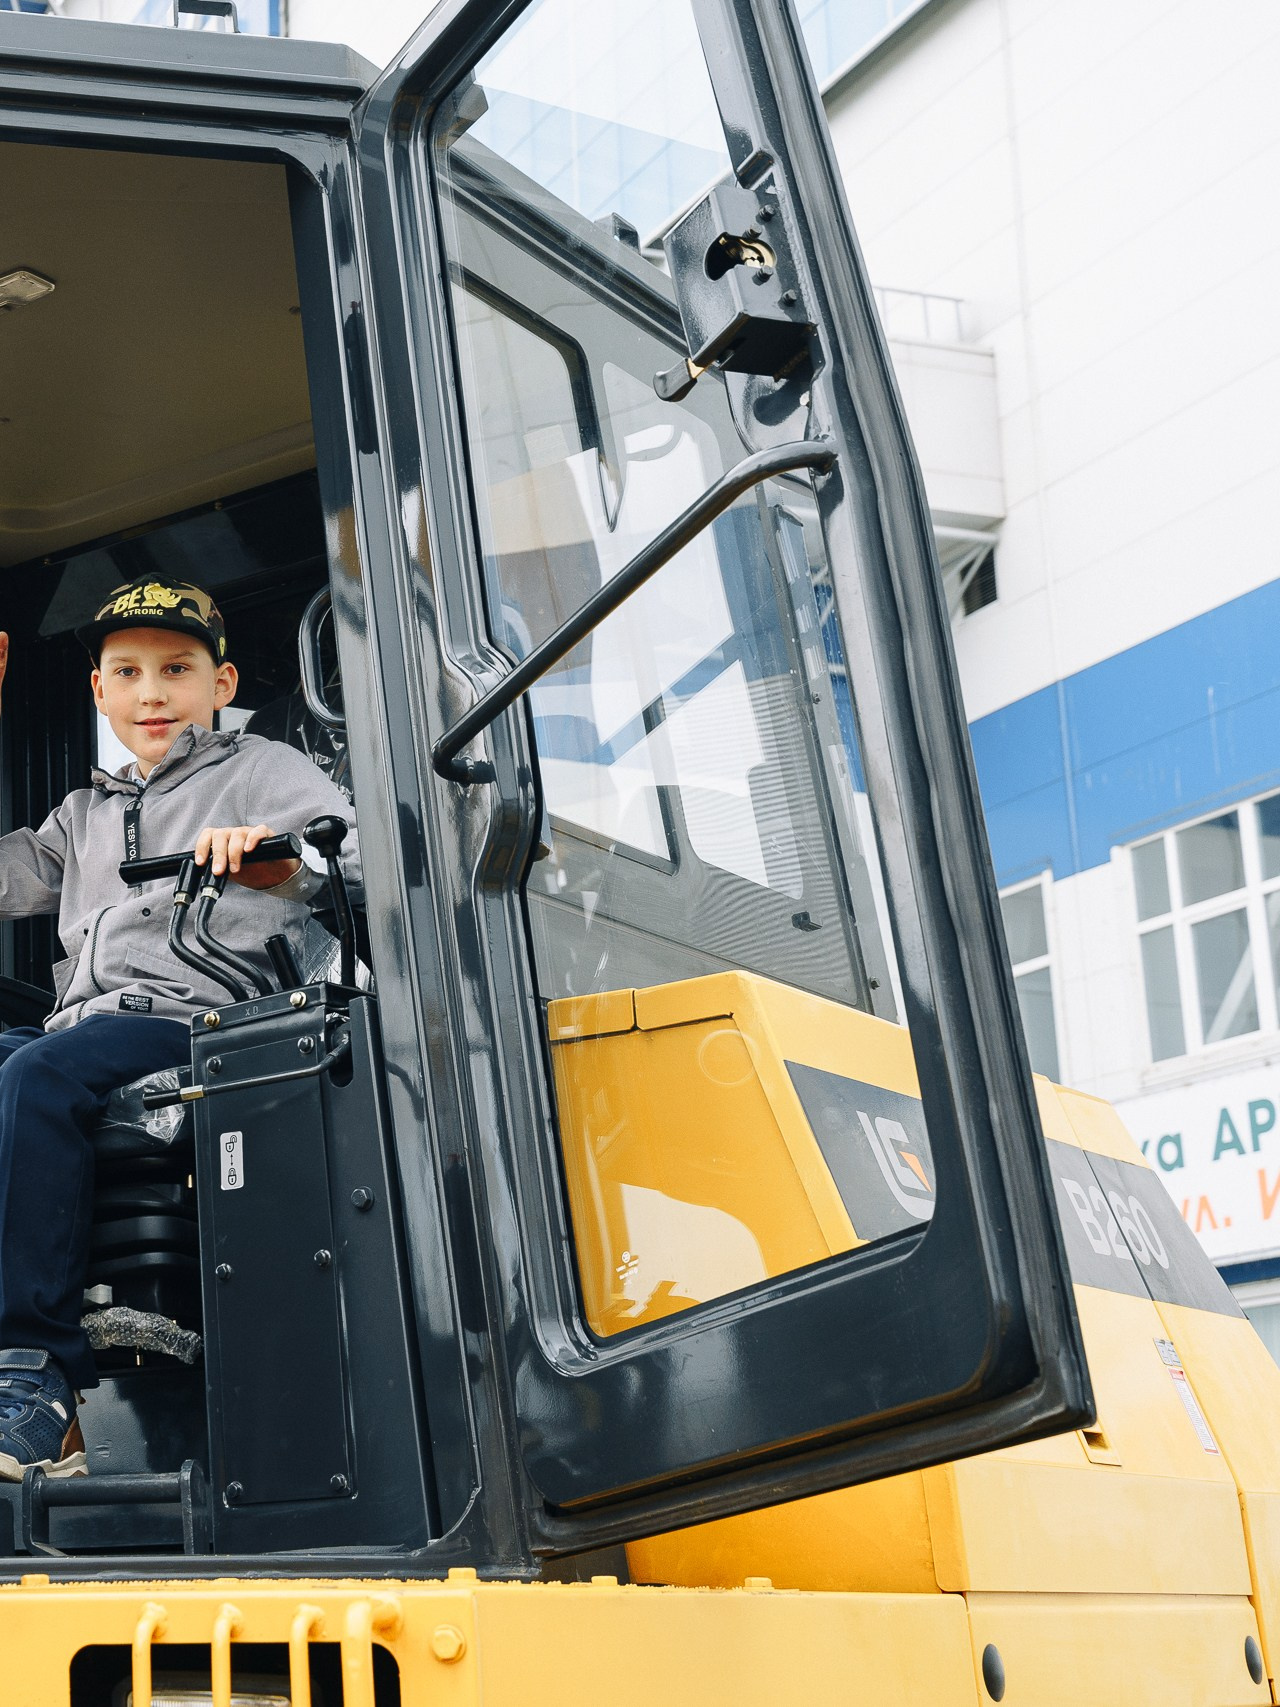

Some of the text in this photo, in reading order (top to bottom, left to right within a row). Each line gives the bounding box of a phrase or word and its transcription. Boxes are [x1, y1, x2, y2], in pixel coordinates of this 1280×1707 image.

[112, 586, 143, 615] BE
[122, 607, 164, 618] STRONG
[1060, 1177, 1170, 1270] B260
